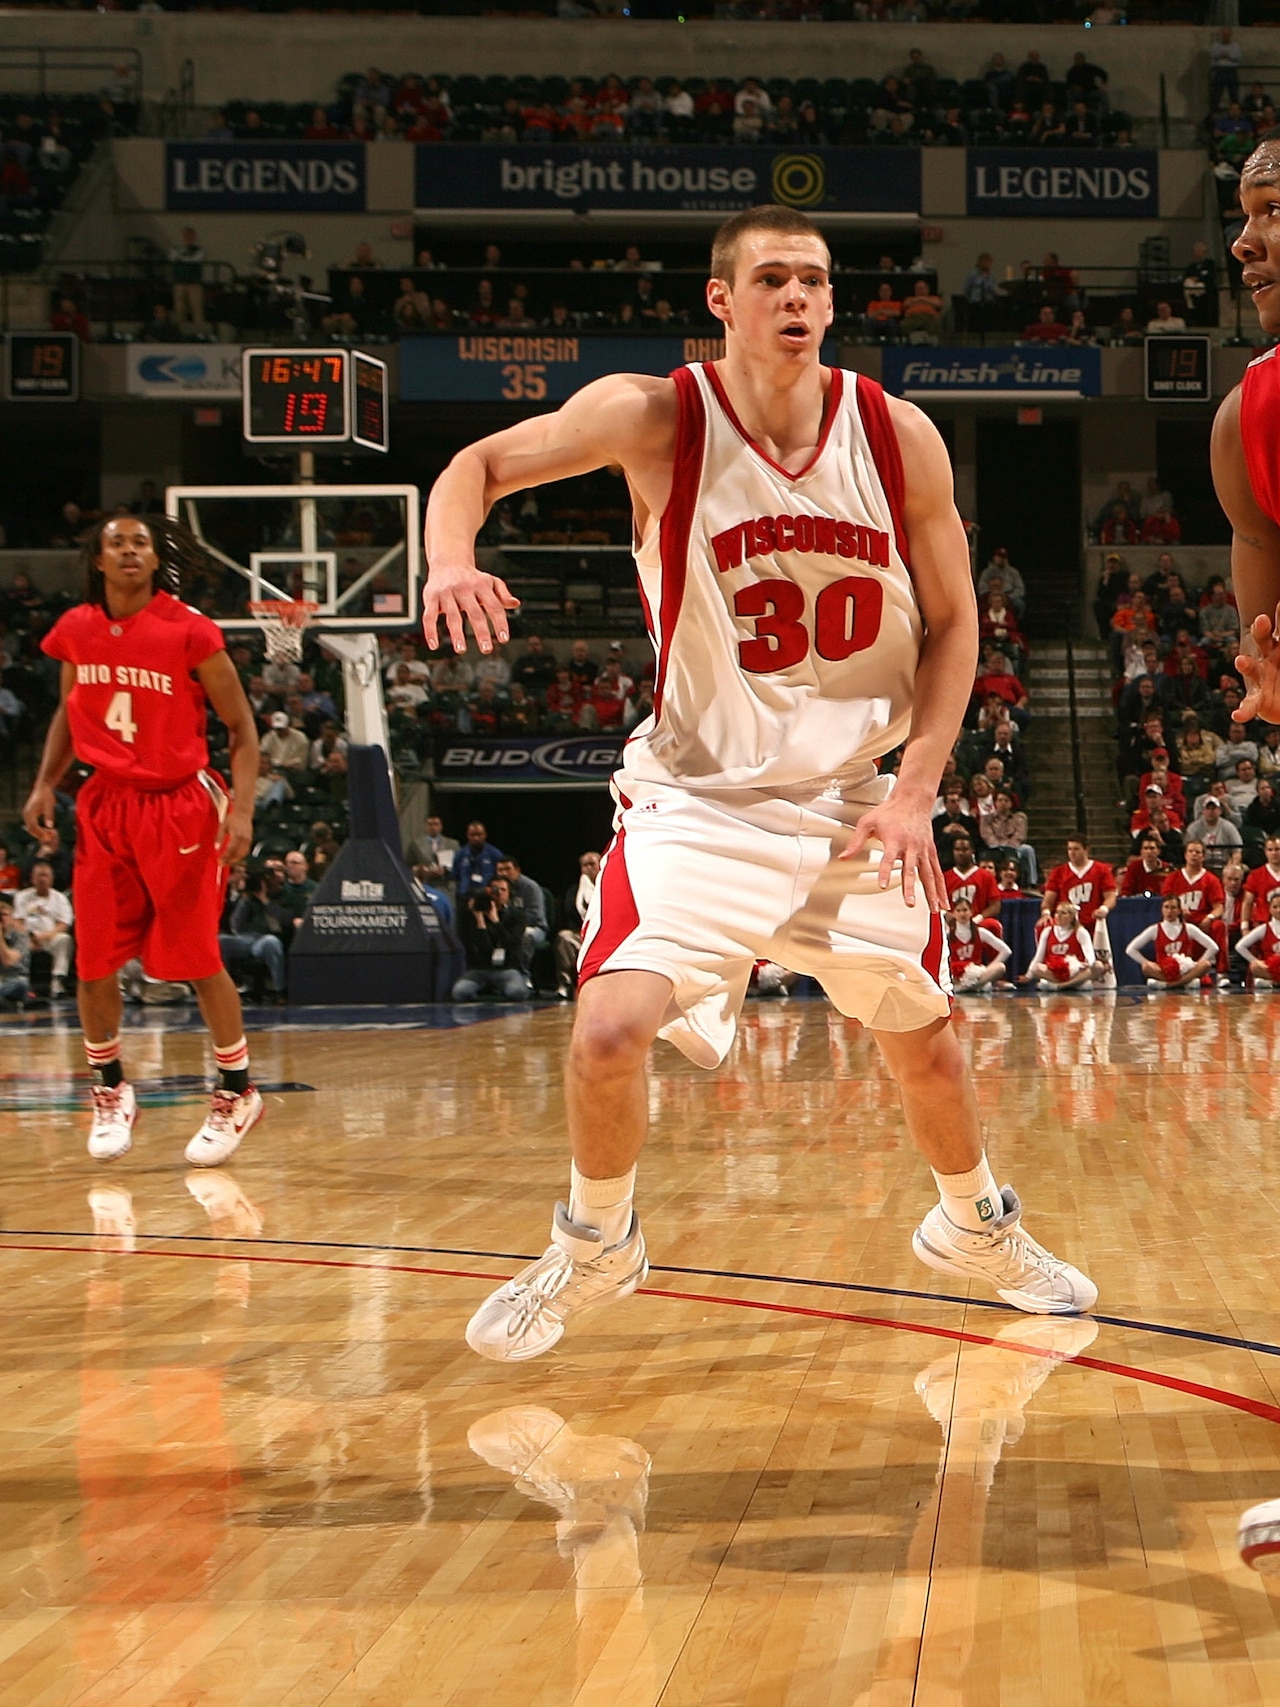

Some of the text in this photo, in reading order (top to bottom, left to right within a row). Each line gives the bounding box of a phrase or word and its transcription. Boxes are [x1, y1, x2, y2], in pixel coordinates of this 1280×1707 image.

[174, 158, 358, 193] LEGENDS
[502, 158, 757, 199] bright house
[976, 167, 1151, 199] LEGENDS
[32, 345, 64, 376] 19
[458, 337, 579, 362] WISCONSIN
[1169, 349, 1198, 378] 19
[262, 357, 342, 384] 16:47
[502, 364, 548, 400] 35
[902, 361, 999, 383] Finish
[284, 393, 328, 432] 19
[711, 514, 890, 573] WISCONSIN
[734, 576, 883, 674] 30
[115, 665, 174, 696] STATE
[104, 691, 138, 744] 4
[442, 749, 530, 766] BUD
[1068, 882, 1093, 905] W
[1178, 890, 1203, 911] W
[311, 915, 408, 928] TOURNAMENT
